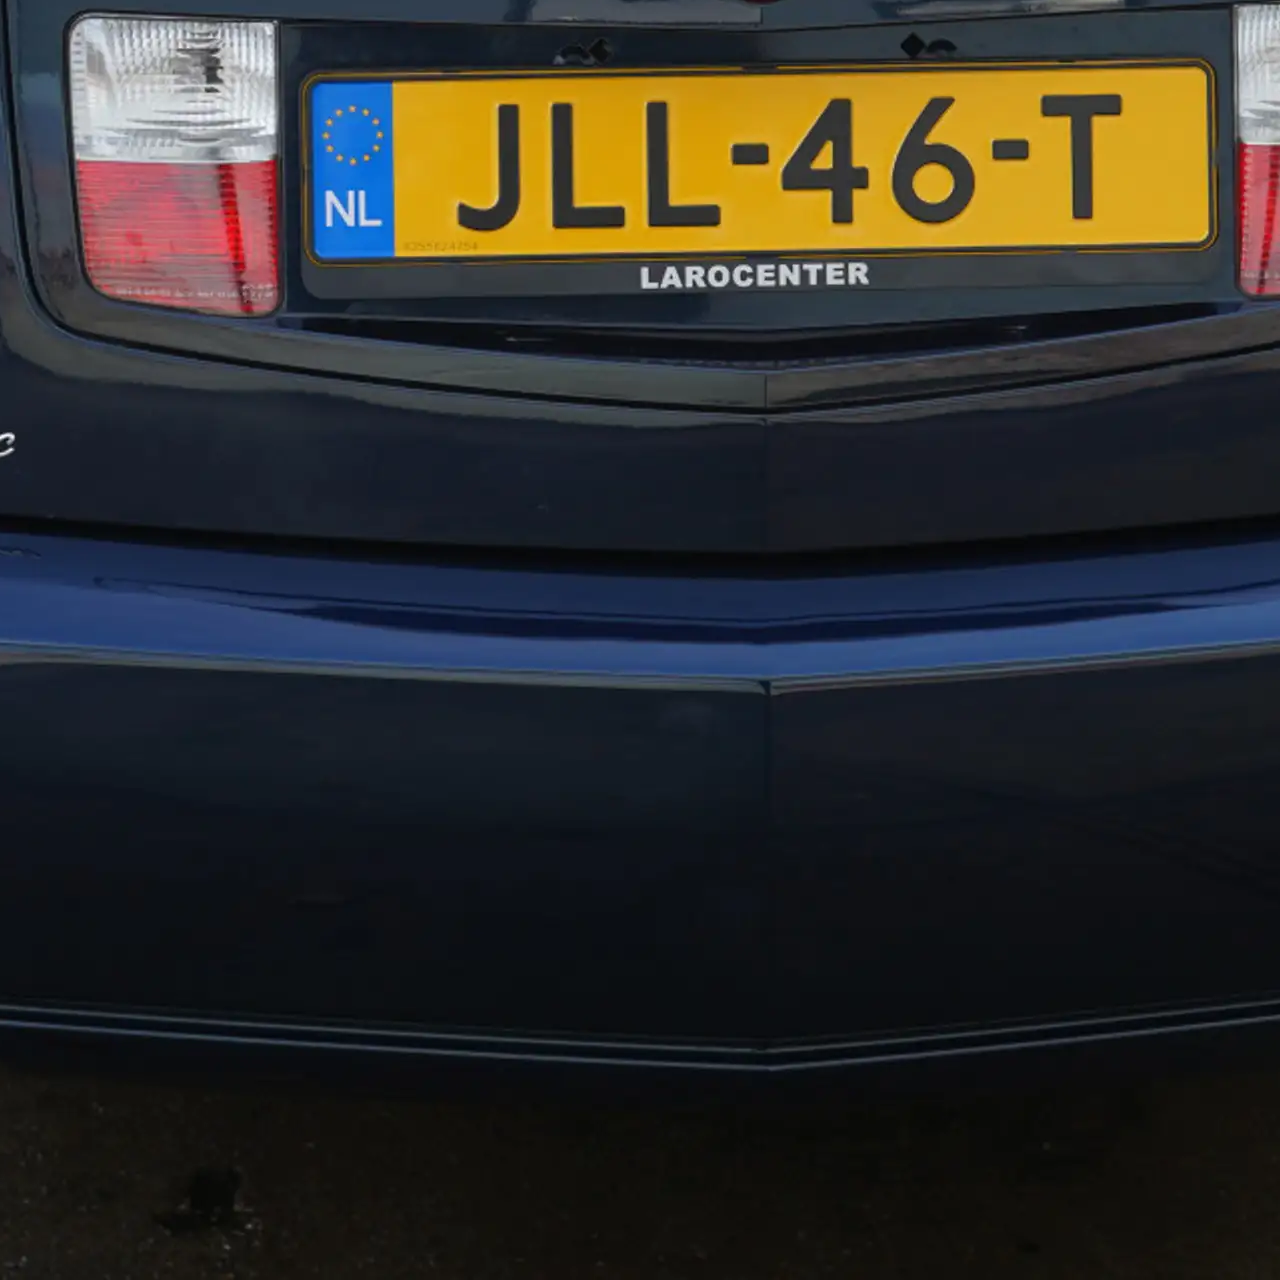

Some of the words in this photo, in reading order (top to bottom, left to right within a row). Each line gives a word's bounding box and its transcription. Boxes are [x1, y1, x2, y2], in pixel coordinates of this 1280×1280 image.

[458, 94, 1122, 232] JLL-46-T
[324, 190, 383, 228] NL
[640, 262, 869, 290] LAROCENTER
